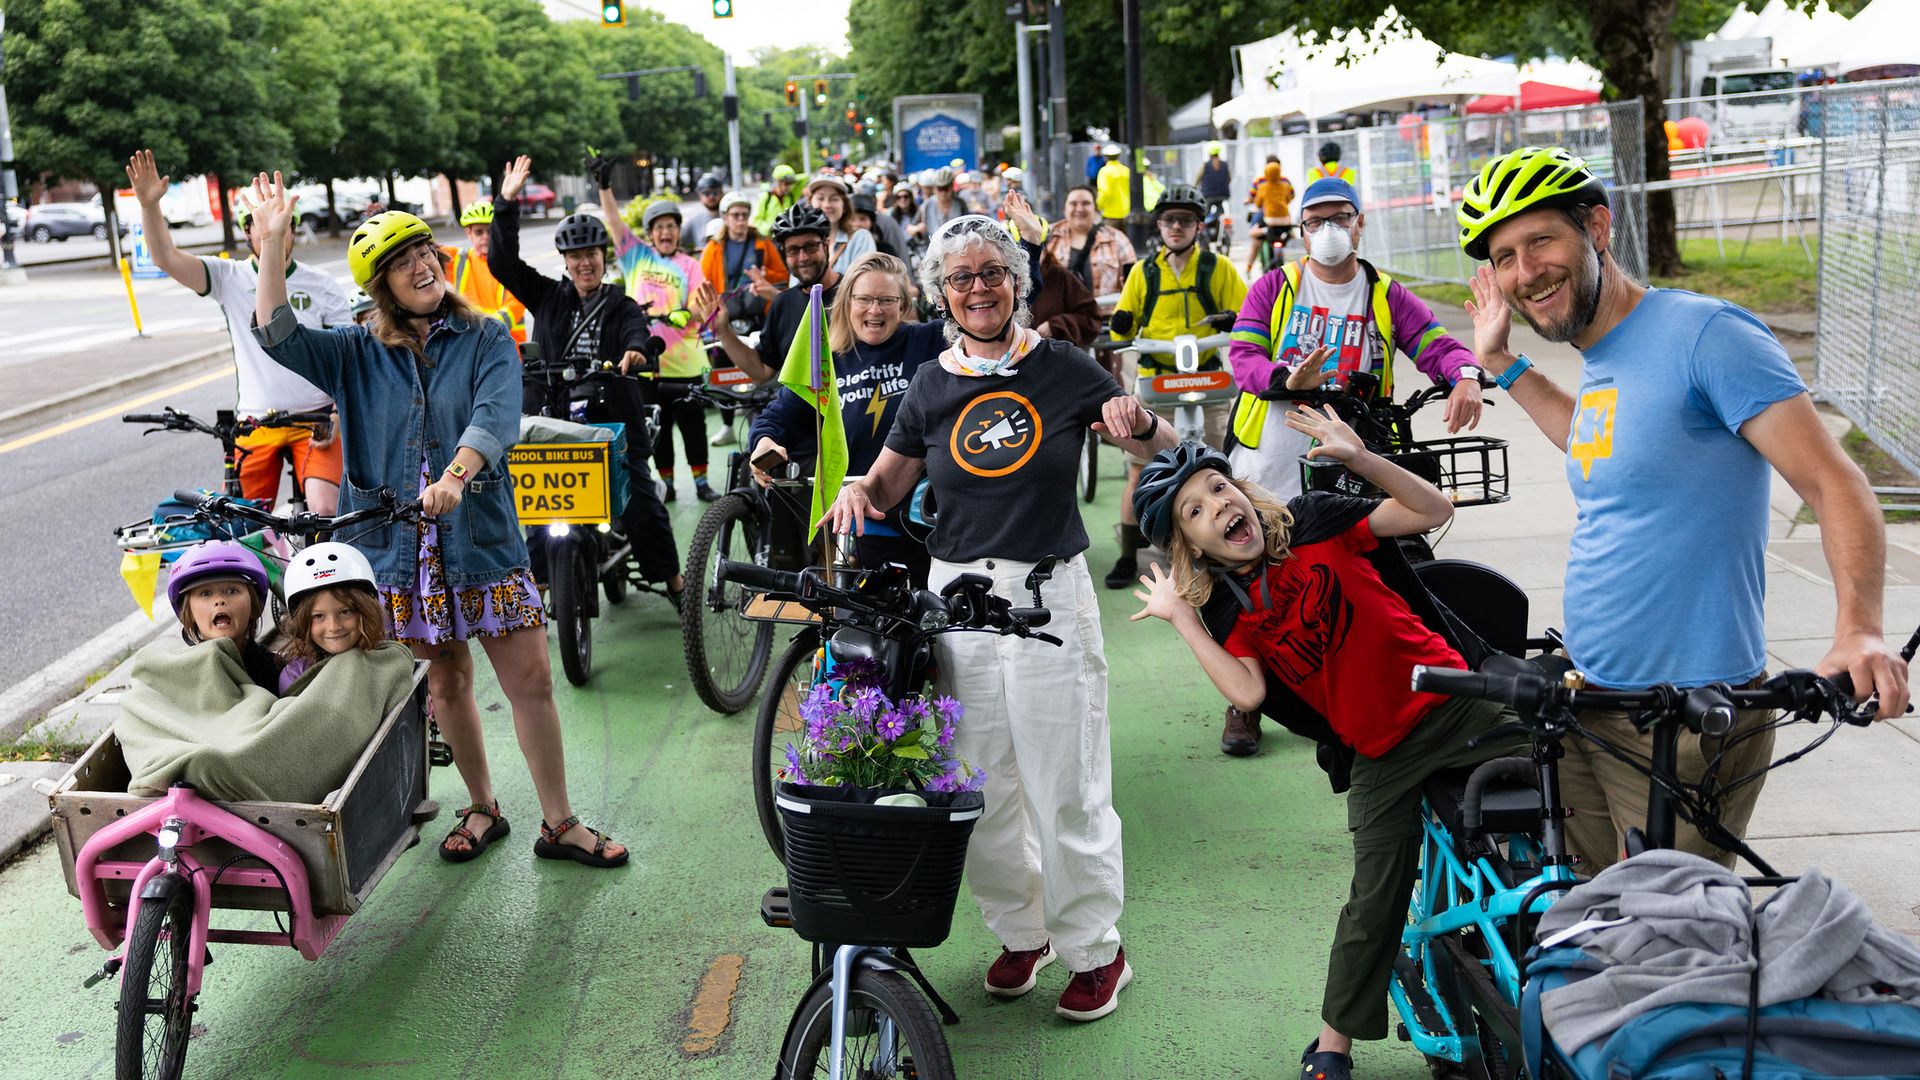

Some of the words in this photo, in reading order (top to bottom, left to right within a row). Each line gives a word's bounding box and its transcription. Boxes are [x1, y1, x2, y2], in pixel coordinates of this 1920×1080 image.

[1290, 310, 1363, 347] HOTH
[836, 361, 904, 388] electrify
[1163, 376, 1212, 389] BIKETOWN
[839, 387, 874, 411] your
[880, 377, 909, 395] life
[507, 451, 543, 462] CHOOL
[545, 451, 571, 461] BIKE
[572, 450, 595, 460] BUS
[543, 471, 591, 490] NOT
[521, 493, 575, 512] PASS
